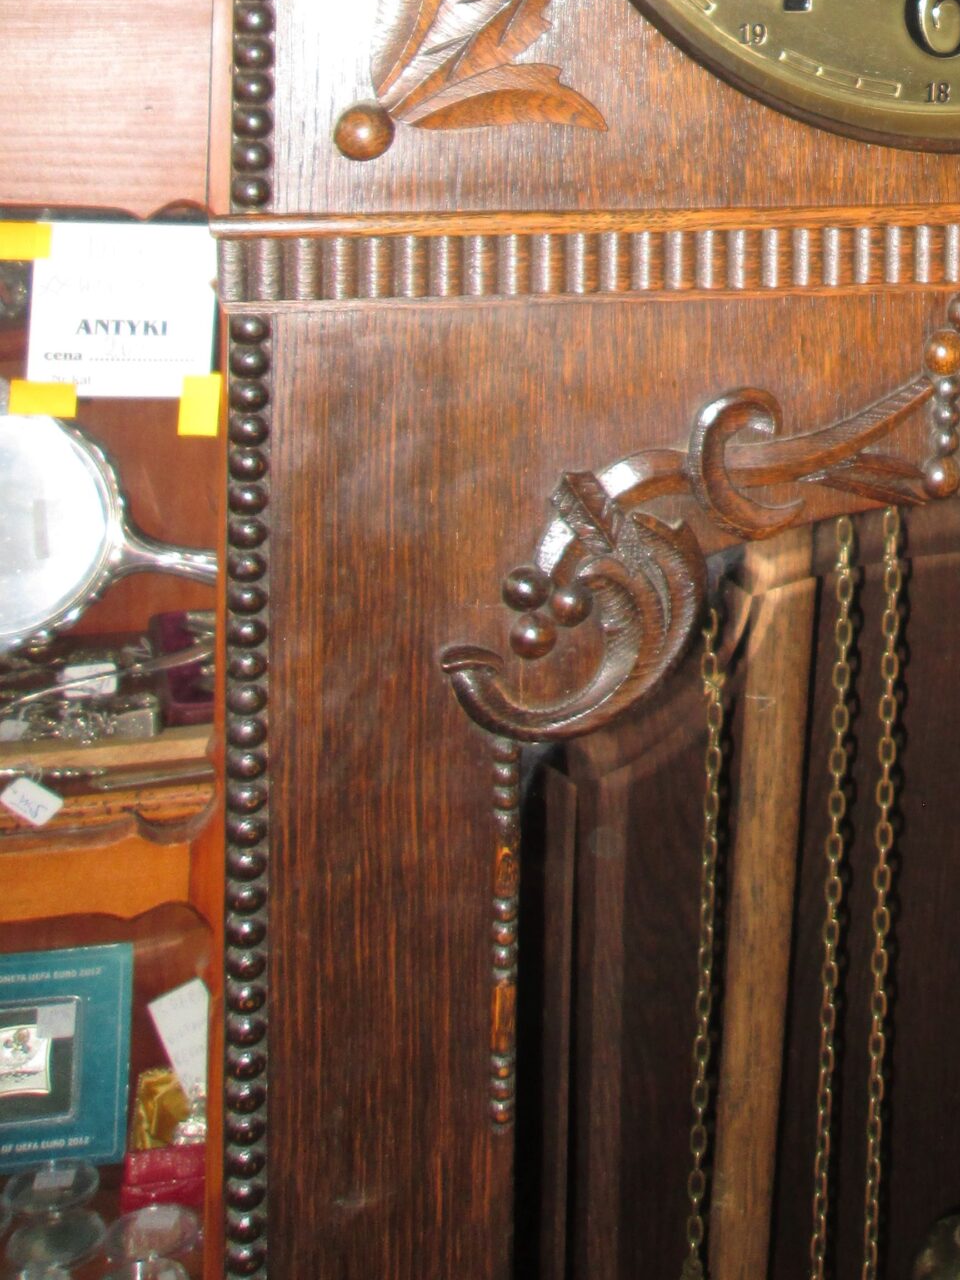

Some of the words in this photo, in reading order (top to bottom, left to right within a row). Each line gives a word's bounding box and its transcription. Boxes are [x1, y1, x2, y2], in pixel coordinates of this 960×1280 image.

[739, 23, 768, 46] 19
[925, 81, 951, 104] 18
[75, 318, 168, 336] ANTYKI
[43, 351, 83, 361] cena
[28, 970, 51, 982] UEFA
[53, 968, 77, 979] EURO
[1, 1143, 14, 1154] OF
[15, 1141, 38, 1152] UEFA
[40, 1138, 66, 1150] EURO
[68, 1136, 91, 1147] 2012
